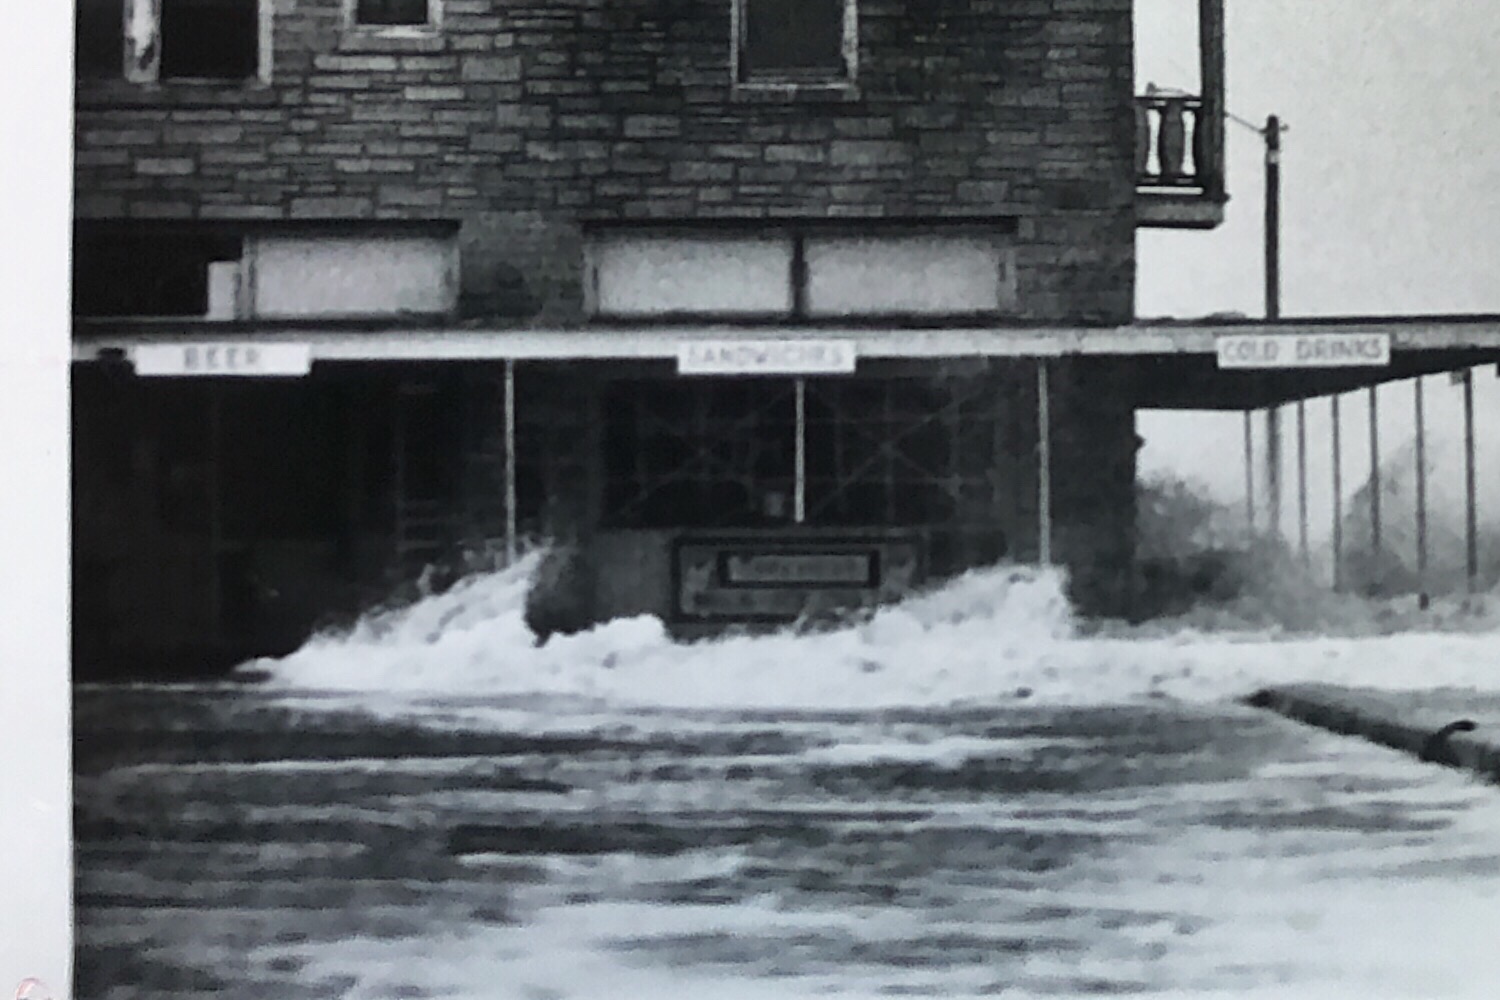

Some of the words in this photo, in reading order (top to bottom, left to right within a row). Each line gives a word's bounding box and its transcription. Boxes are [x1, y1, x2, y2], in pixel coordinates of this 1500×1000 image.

[183, 346, 261, 369] BEER
[1223, 340, 1281, 362] COLD
[1295, 338, 1383, 360] DRINKS
